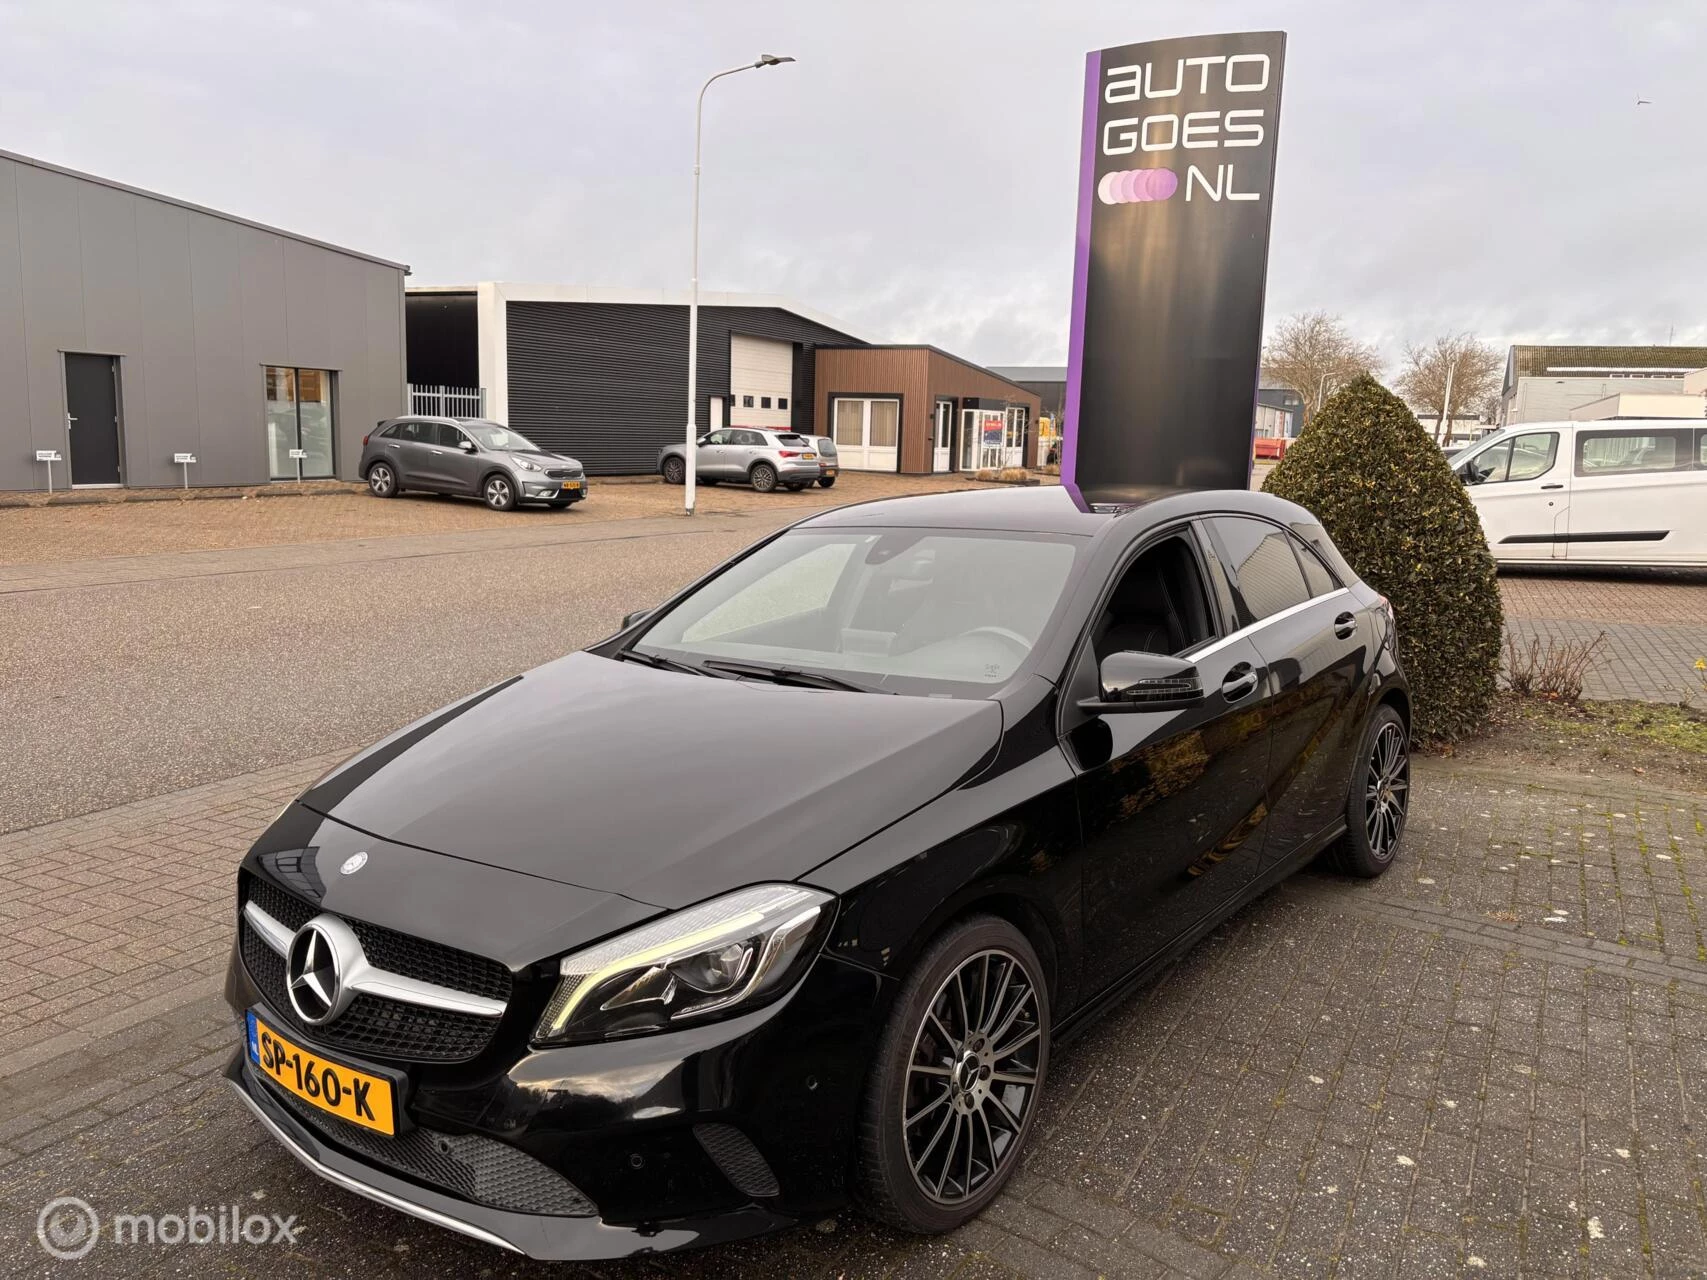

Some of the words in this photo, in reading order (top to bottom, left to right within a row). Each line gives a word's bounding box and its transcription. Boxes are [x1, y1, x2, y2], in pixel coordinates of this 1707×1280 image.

[1103, 109, 1264, 155] GOES
[1186, 164, 1260, 201] NL
[261, 1032, 376, 1121] SP-160-K
